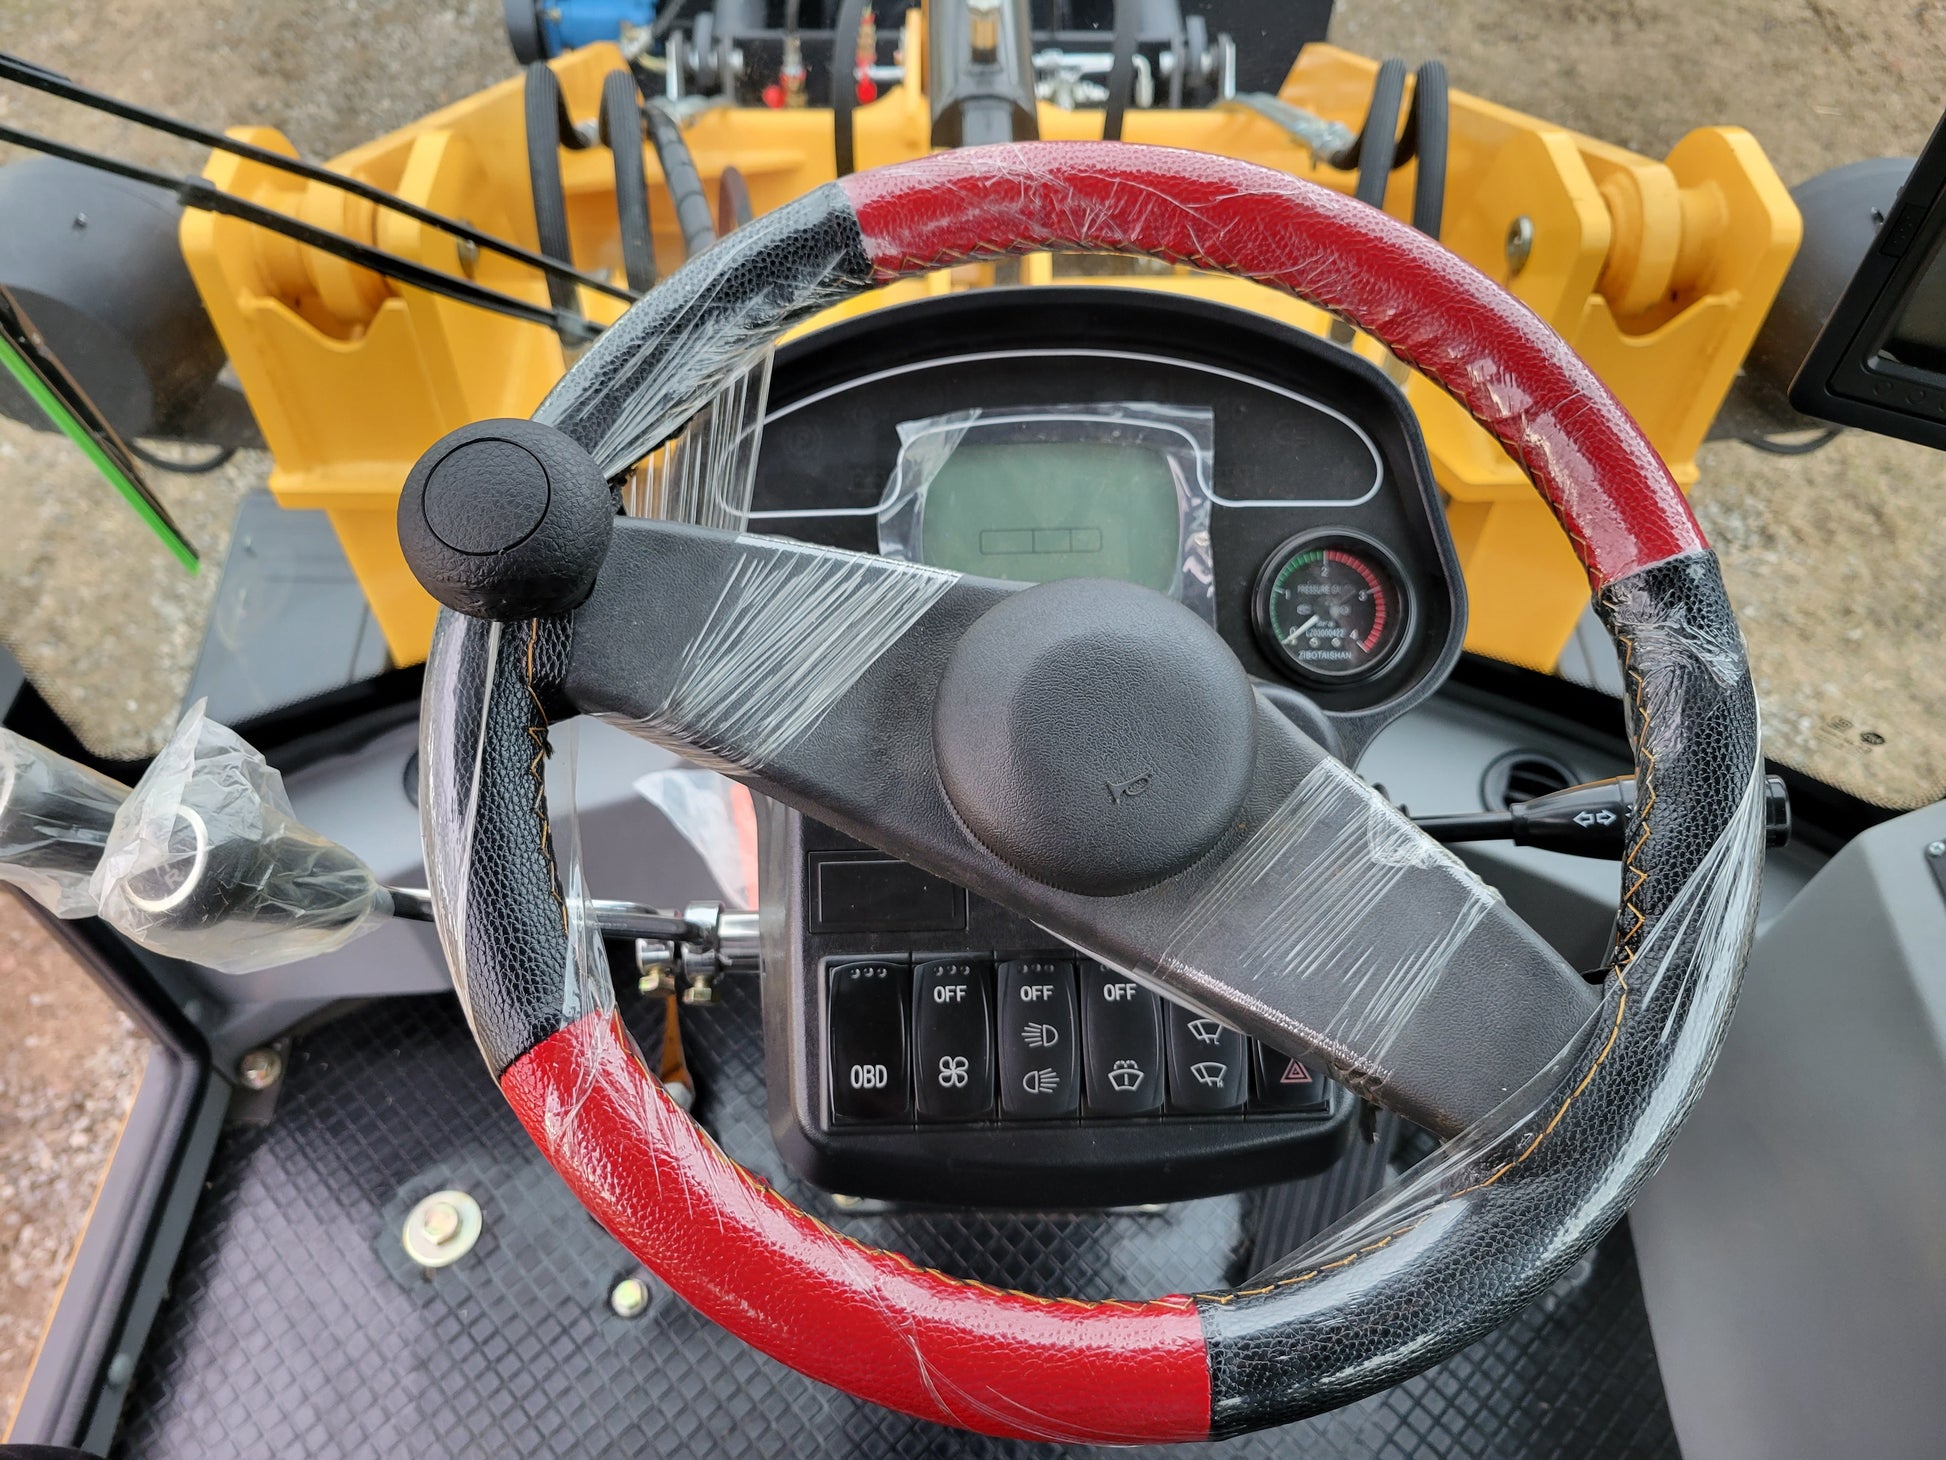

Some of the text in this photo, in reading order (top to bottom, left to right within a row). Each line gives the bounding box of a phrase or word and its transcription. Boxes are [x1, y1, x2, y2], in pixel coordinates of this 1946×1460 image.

[1321, 568, 1328, 577] 2
[1285, 590, 1290, 600] 1
[1298, 585, 1330, 595] PRESSURE
[1358, 592, 1366, 601] 3
[1350, 629, 1358, 640] 4
[1298, 651, 1352, 659] ZIBOTAISHAN
[933, 985, 967, 1004] OFF
[1020, 984, 1054, 1002] OFF
[1103, 983, 1137, 1002] OFF
[850, 1064, 888, 1090] OBD
